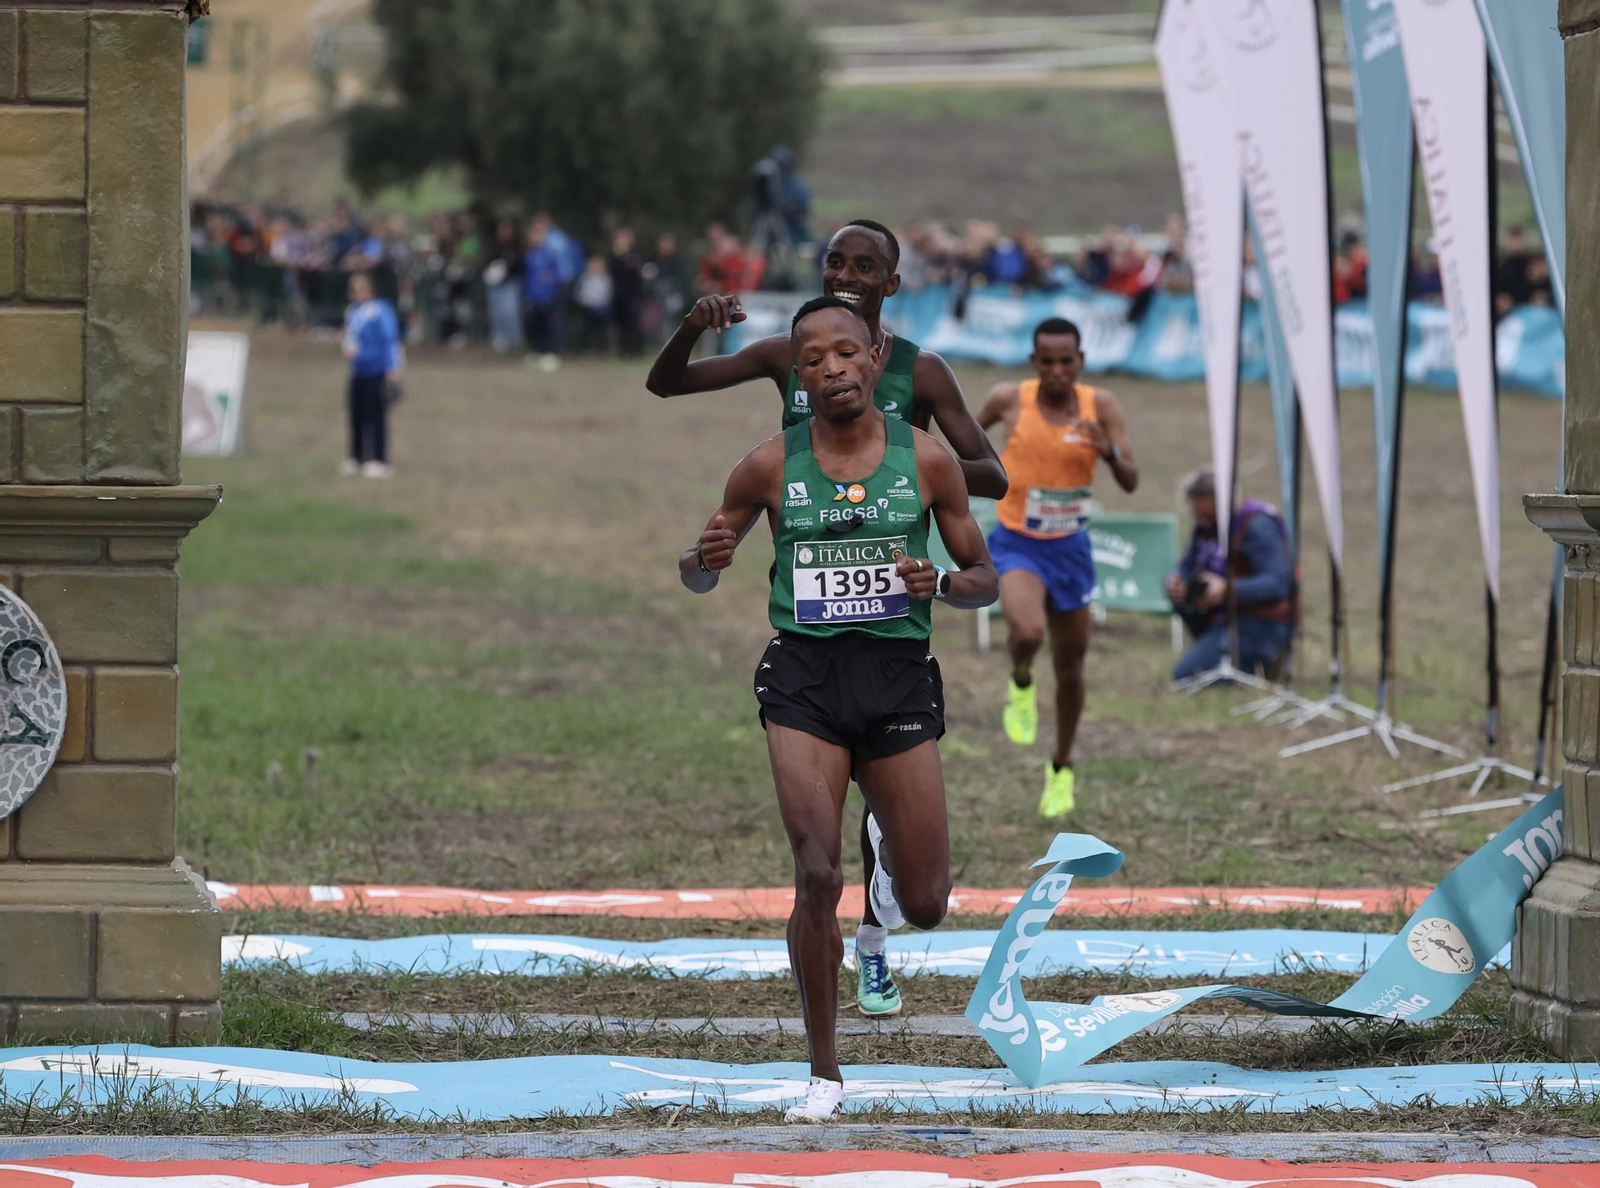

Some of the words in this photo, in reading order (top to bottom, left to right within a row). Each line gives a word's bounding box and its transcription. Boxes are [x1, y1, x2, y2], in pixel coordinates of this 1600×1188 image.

[849, 488, 864, 497] Fer
[785, 498, 812, 508] rasán
[820, 506, 879, 523] Facsa
[819, 545, 885, 562] ITÁLICA
[814, 568, 891, 597] 1395
[822, 599, 885, 619] Joma
[900, 722, 921, 731] rasán
[1064, 1006, 1131, 1038] Sevilla
